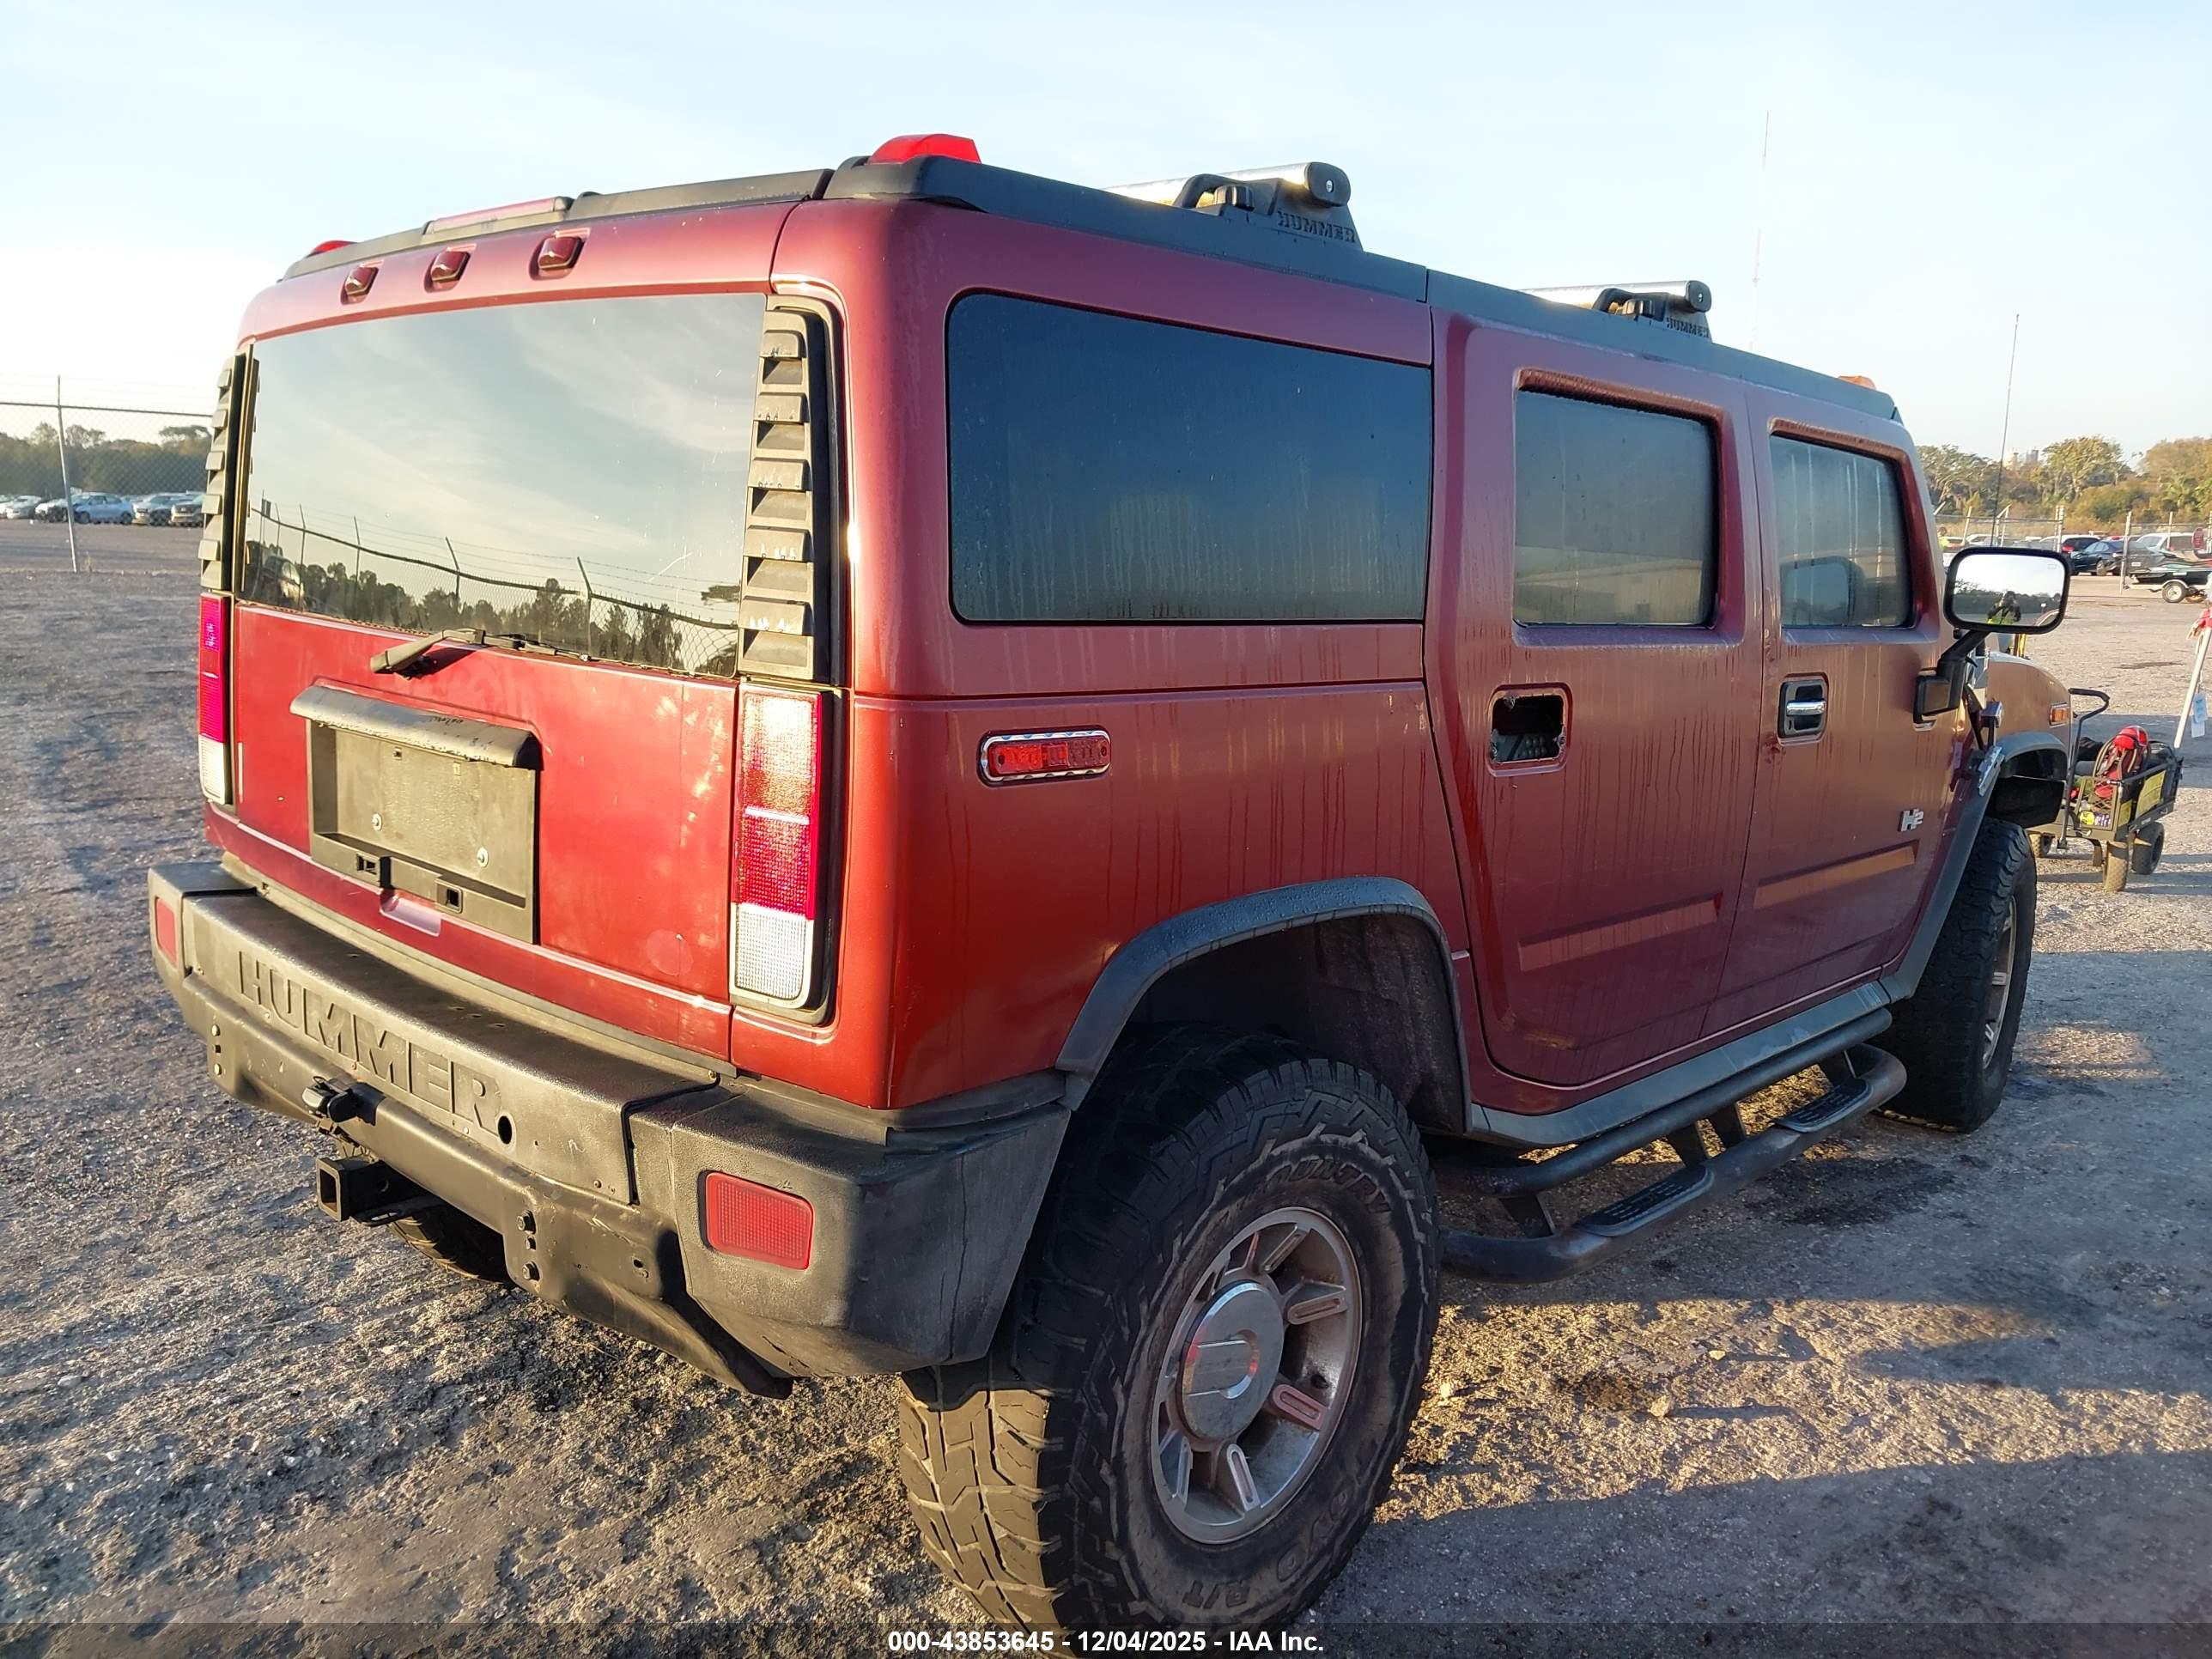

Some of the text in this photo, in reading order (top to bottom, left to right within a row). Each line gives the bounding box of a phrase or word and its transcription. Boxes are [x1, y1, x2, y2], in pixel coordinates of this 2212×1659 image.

[1276, 210, 1356, 243] HUMMER
[1899, 808, 1924, 832] H2
[238, 950, 503, 1138] HUMMER
